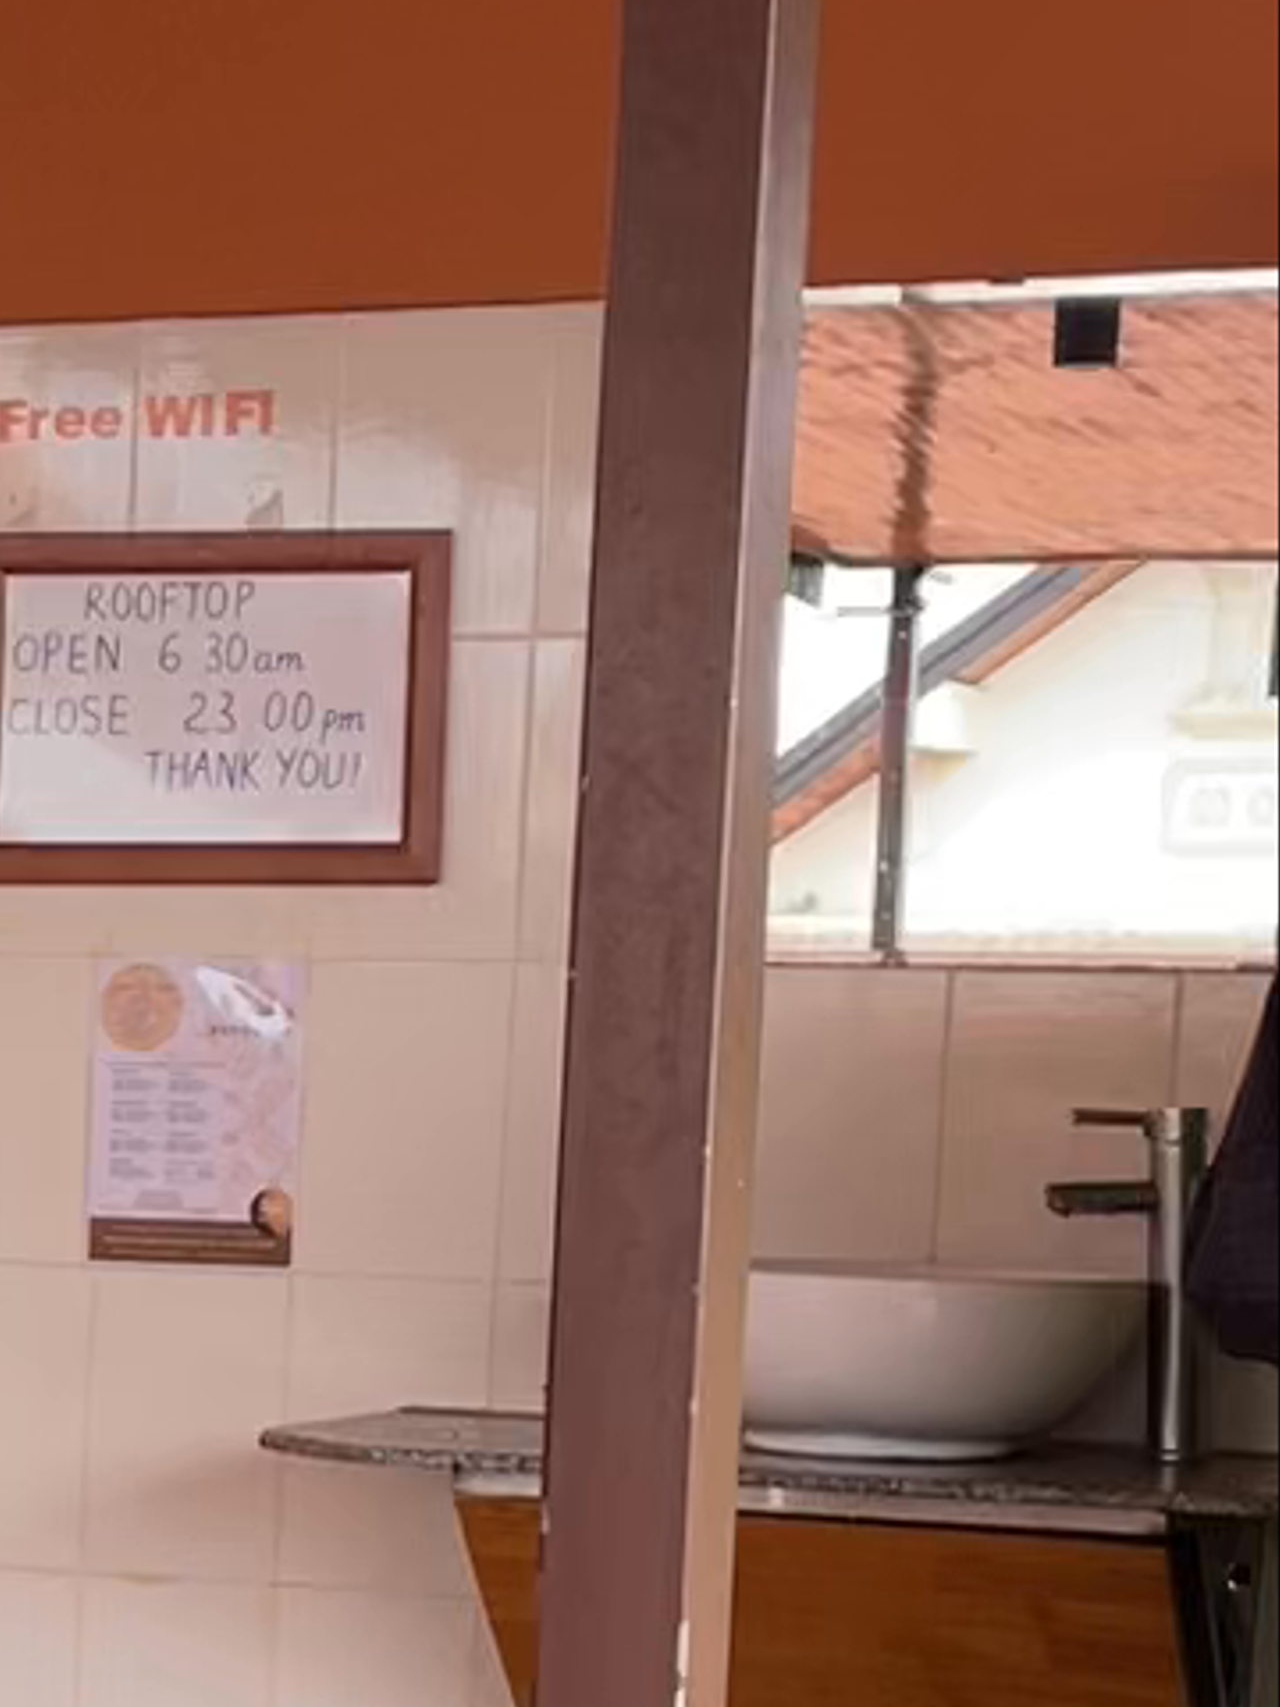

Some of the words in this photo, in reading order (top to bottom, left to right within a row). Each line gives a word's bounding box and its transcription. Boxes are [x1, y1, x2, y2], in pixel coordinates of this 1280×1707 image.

[83, 580, 255, 624] ROOFTOP
[12, 631, 122, 674] OPEN
[7, 694, 130, 736] CLOSE
[144, 749, 260, 791] THANK
[276, 747, 363, 790] YOU!
